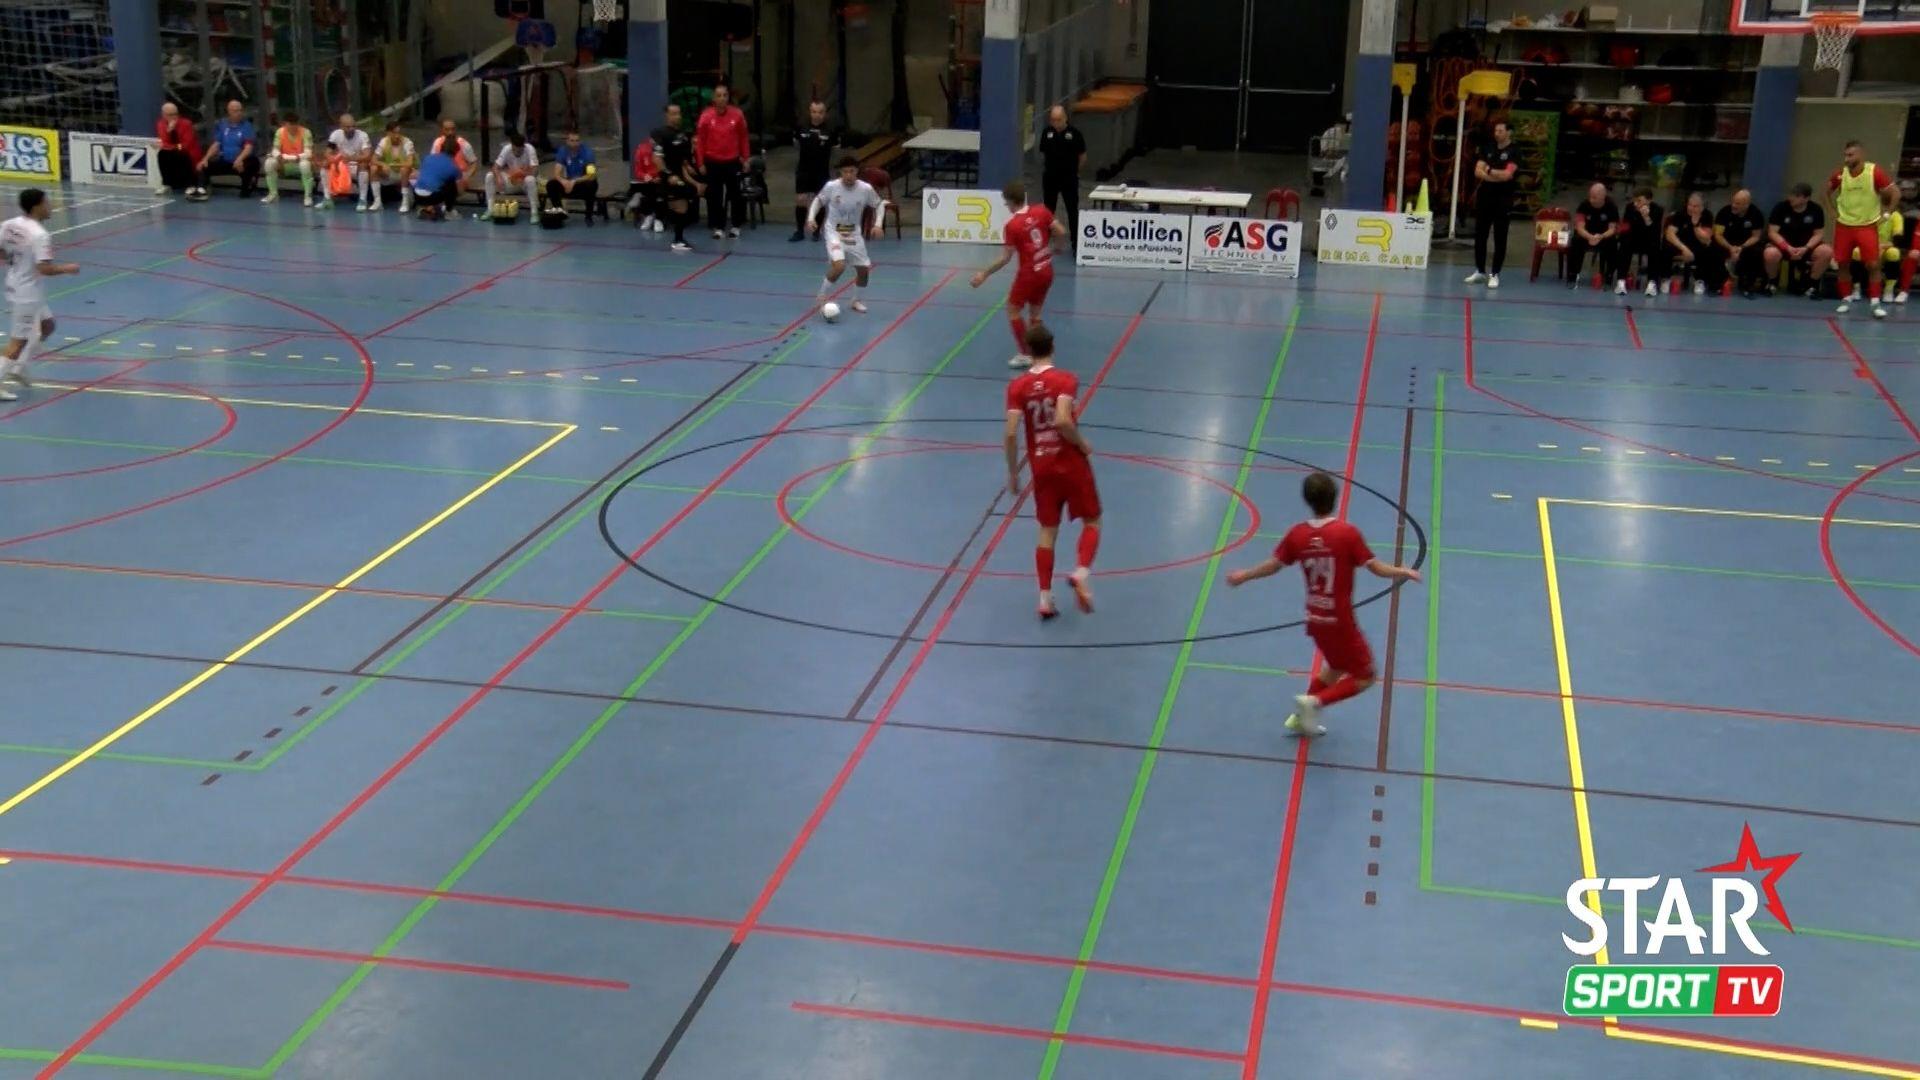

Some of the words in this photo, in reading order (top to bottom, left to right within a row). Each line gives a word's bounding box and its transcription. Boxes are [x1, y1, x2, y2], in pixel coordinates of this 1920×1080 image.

[4, 133, 47, 153] Ice
[2, 151, 49, 172] Tea
[92, 144, 146, 174] MZ
[1102, 218, 1183, 241] baillien
[1223, 221, 1288, 252] ASG
